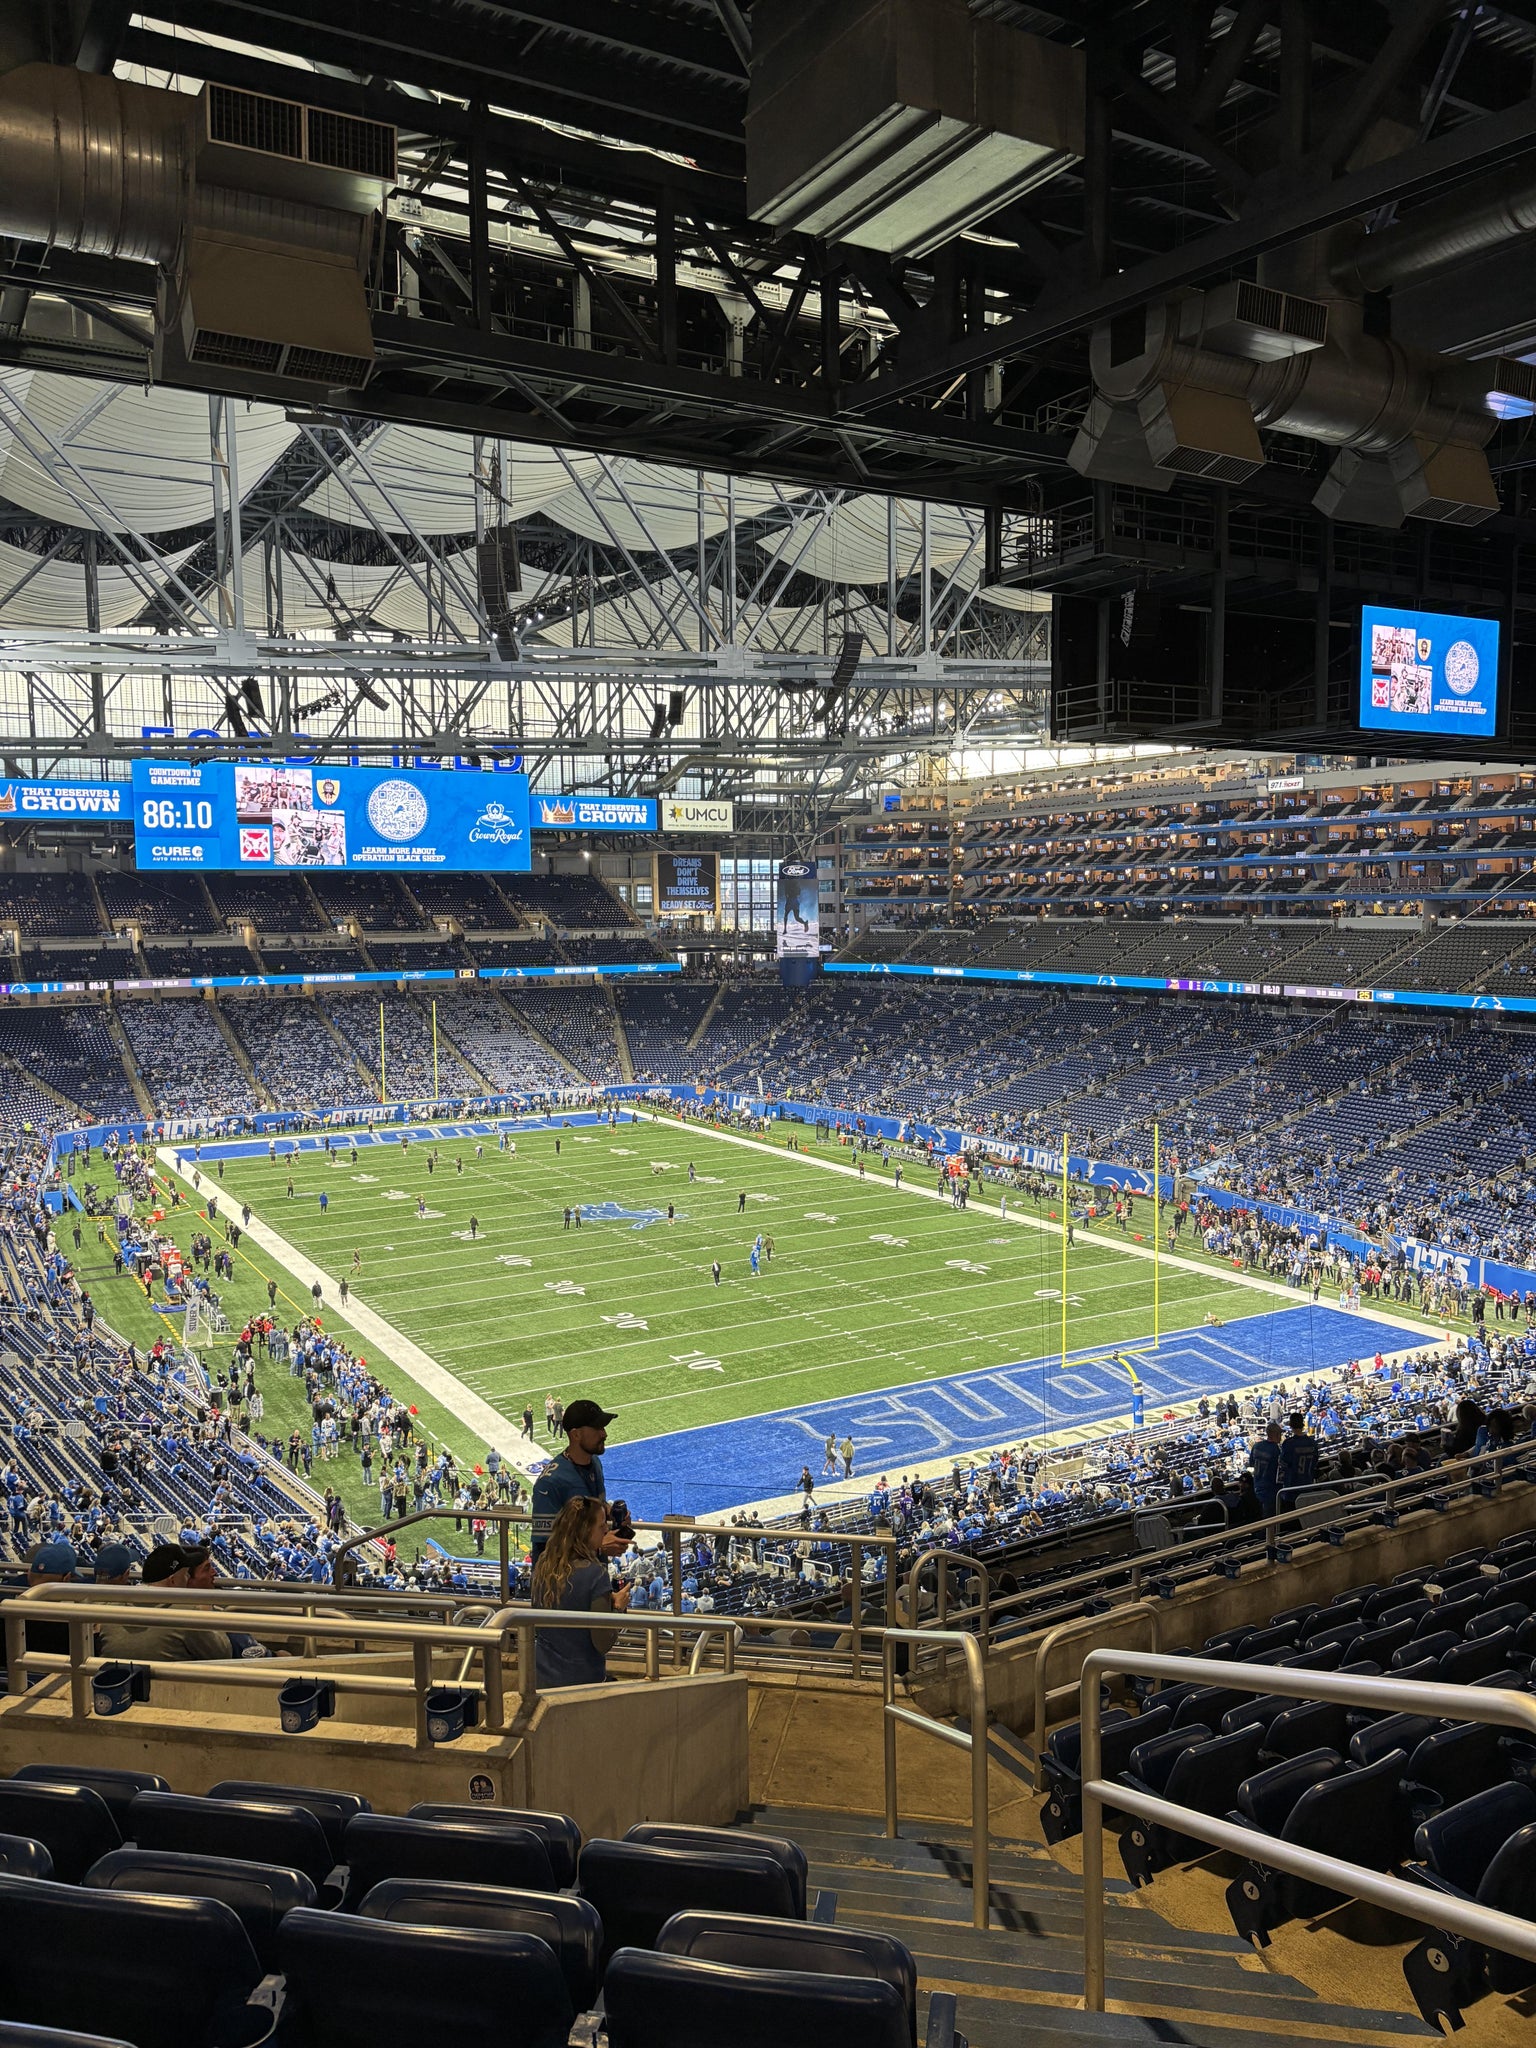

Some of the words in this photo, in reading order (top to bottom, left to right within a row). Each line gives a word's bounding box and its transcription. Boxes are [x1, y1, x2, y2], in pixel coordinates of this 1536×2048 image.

[149, 768, 191, 777] COUNTDOWN
[192, 769, 202, 777] TO
[151, 777, 201, 786] GAMETIME
[22, 787, 51, 796] THAT
[54, 788, 110, 797] DESERVES
[22, 797, 120, 811] CROWN
[579, 803, 600, 811] THAT
[601, 804, 640, 812] DESERVES
[143, 800, 212, 829] 86:10
[579, 810, 647, 823] CROWN
[685, 808, 727, 821] UMCU
[469, 828, 495, 843] Crown
[495, 828, 522, 844] Royal
[152, 846, 191, 855] CURE
[352, 854, 393, 862] OPERATION
[672, 858, 702, 867] DREAMS
[676, 867, 698, 876] DON'T
[677, 877, 698, 886] DRIVE
[666, 886, 709, 896] THEMSELVES
[661, 900, 683, 910] READY
[684, 900, 696, 909] SET
[331, 1106, 399, 1124] DETROIT
[1022, 1148, 1069, 1173] LIONS
[544, 1280, 578, 1295] 30
[600, 1312, 643, 1330] 20
[669, 1350, 721, 1371] 10
[1248, 1885, 1254, 1895] 4
[1434, 1953, 1442, 1966] 5
